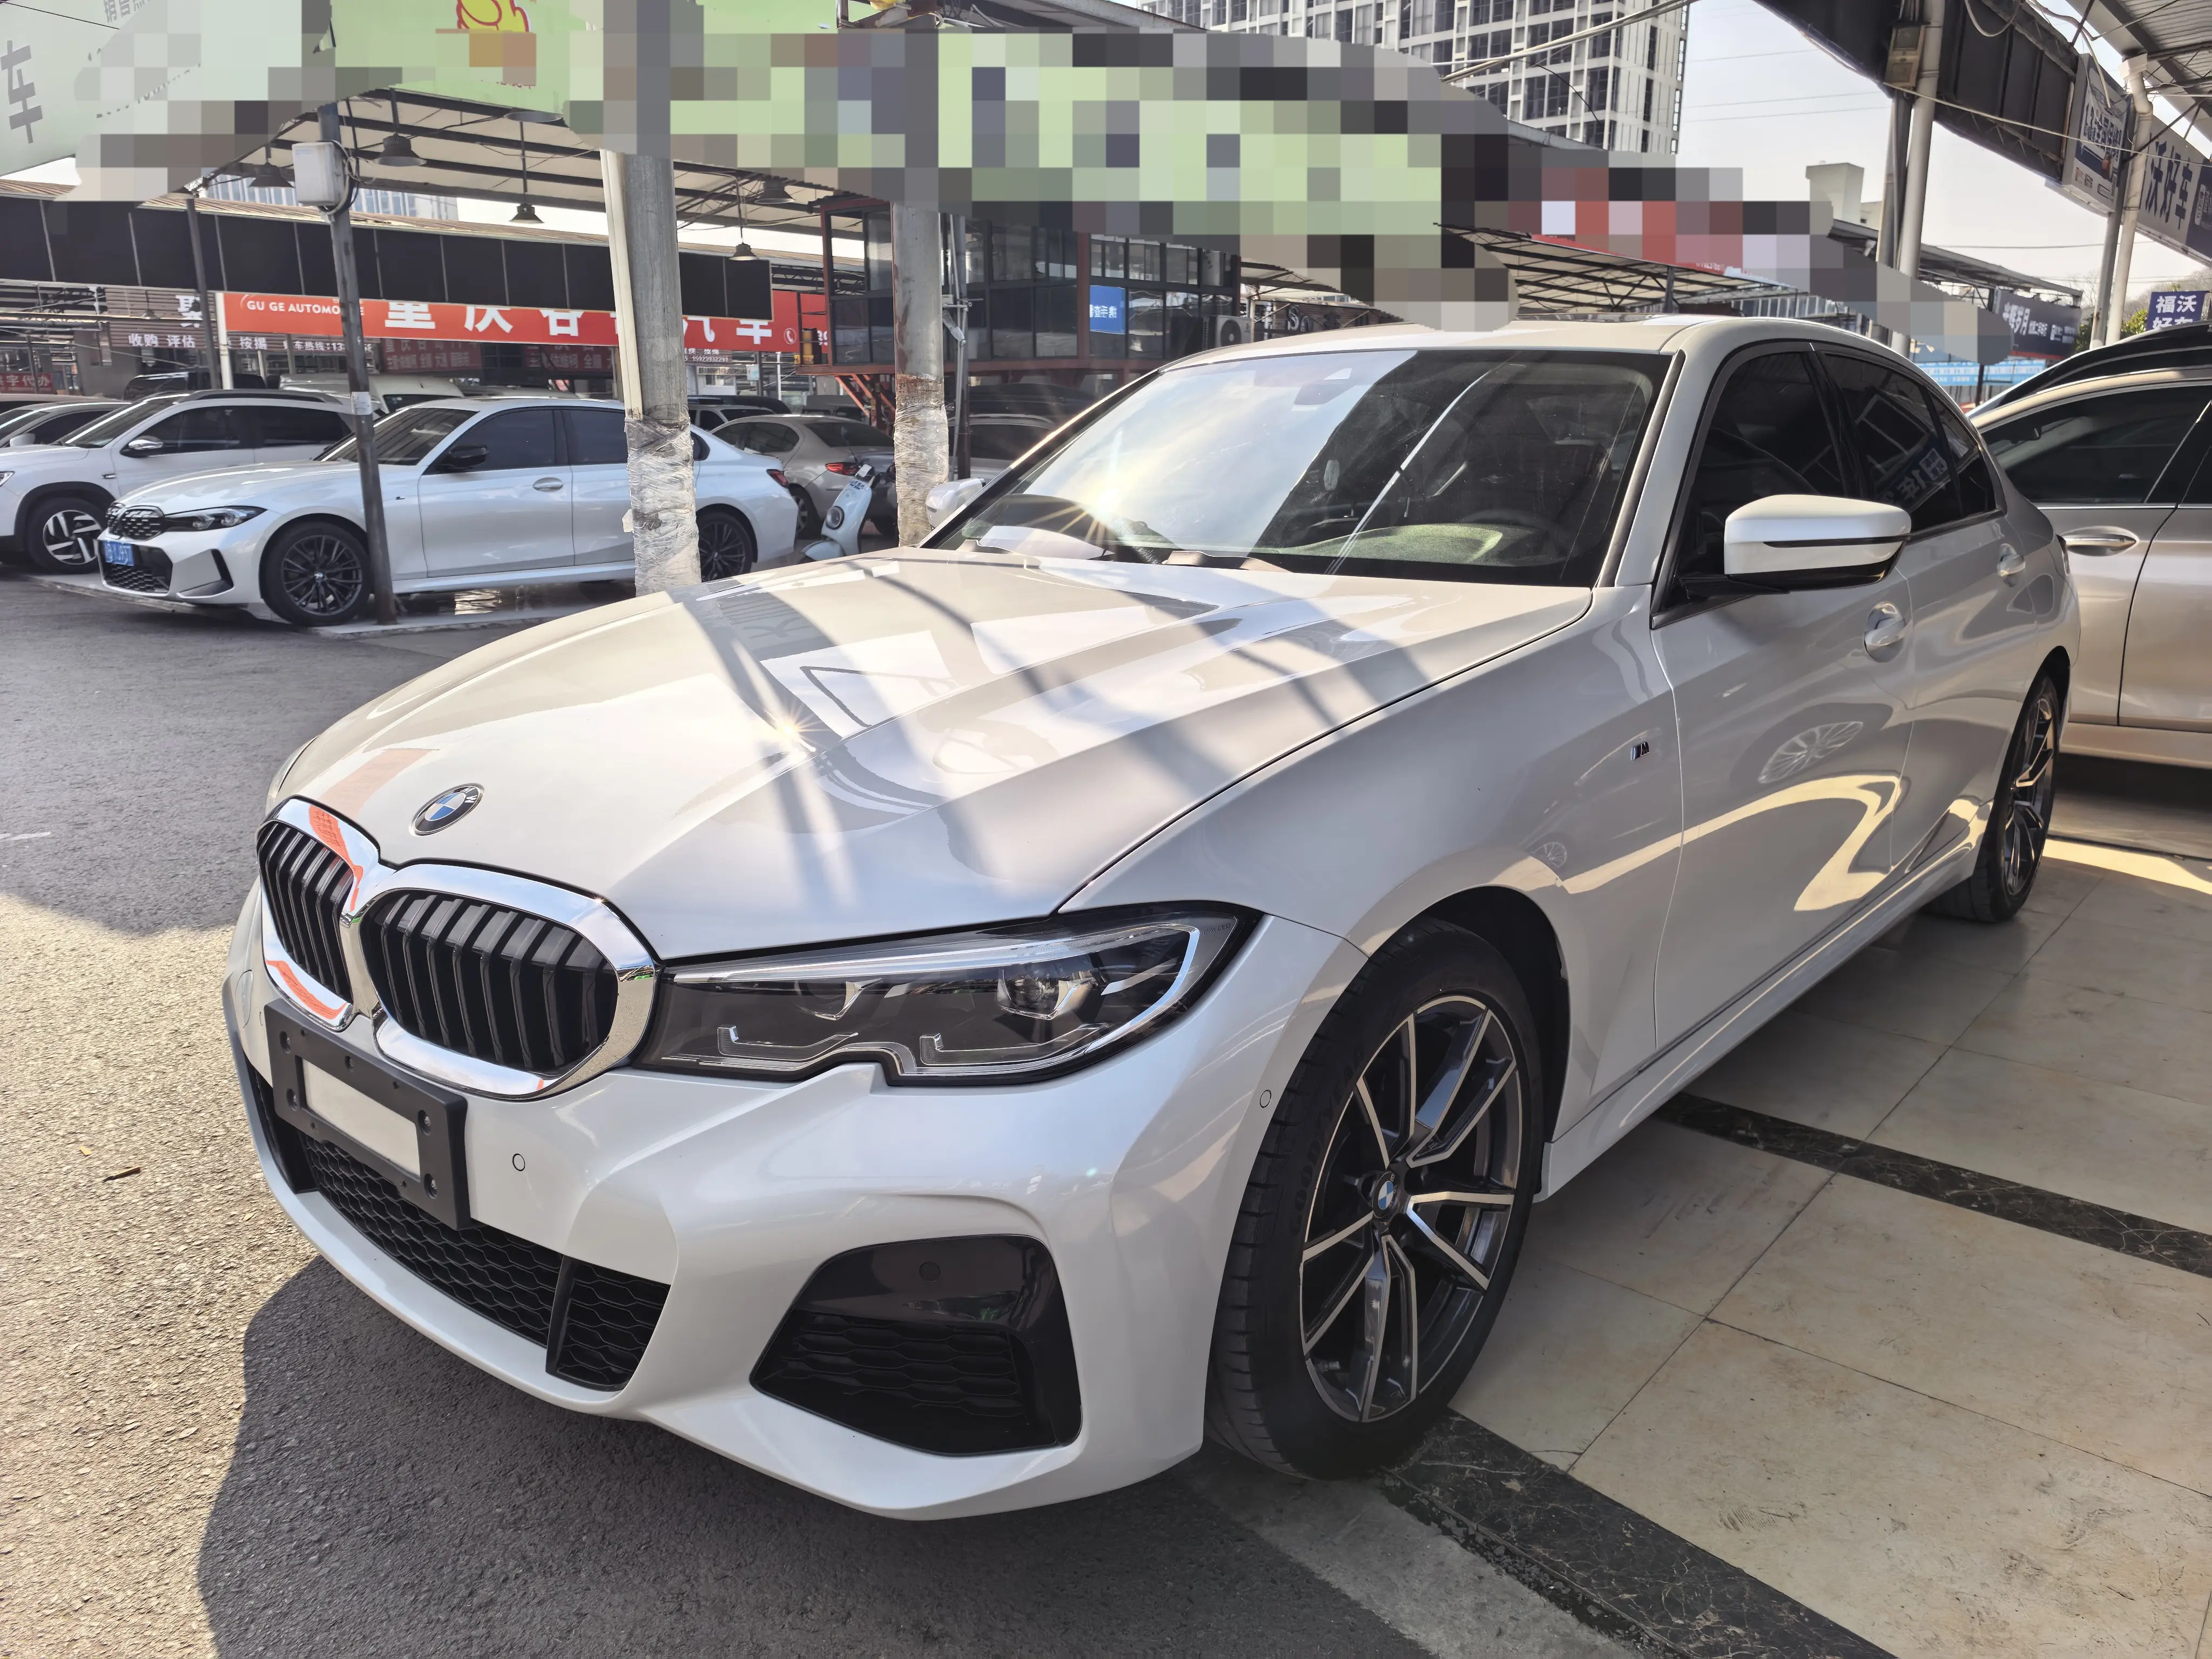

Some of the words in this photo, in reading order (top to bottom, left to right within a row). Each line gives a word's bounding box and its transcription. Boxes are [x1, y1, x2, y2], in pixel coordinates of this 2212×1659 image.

[0, 40, 43, 144] 车
[2146, 140, 2193, 230] 沃好车
[247, 300, 265, 312] GU
[269, 301, 285, 312] GE
[288, 303, 365, 316] AUTOMOE
[2156, 295, 2197, 313] 福沃
[167, 334, 196, 348] 评估
